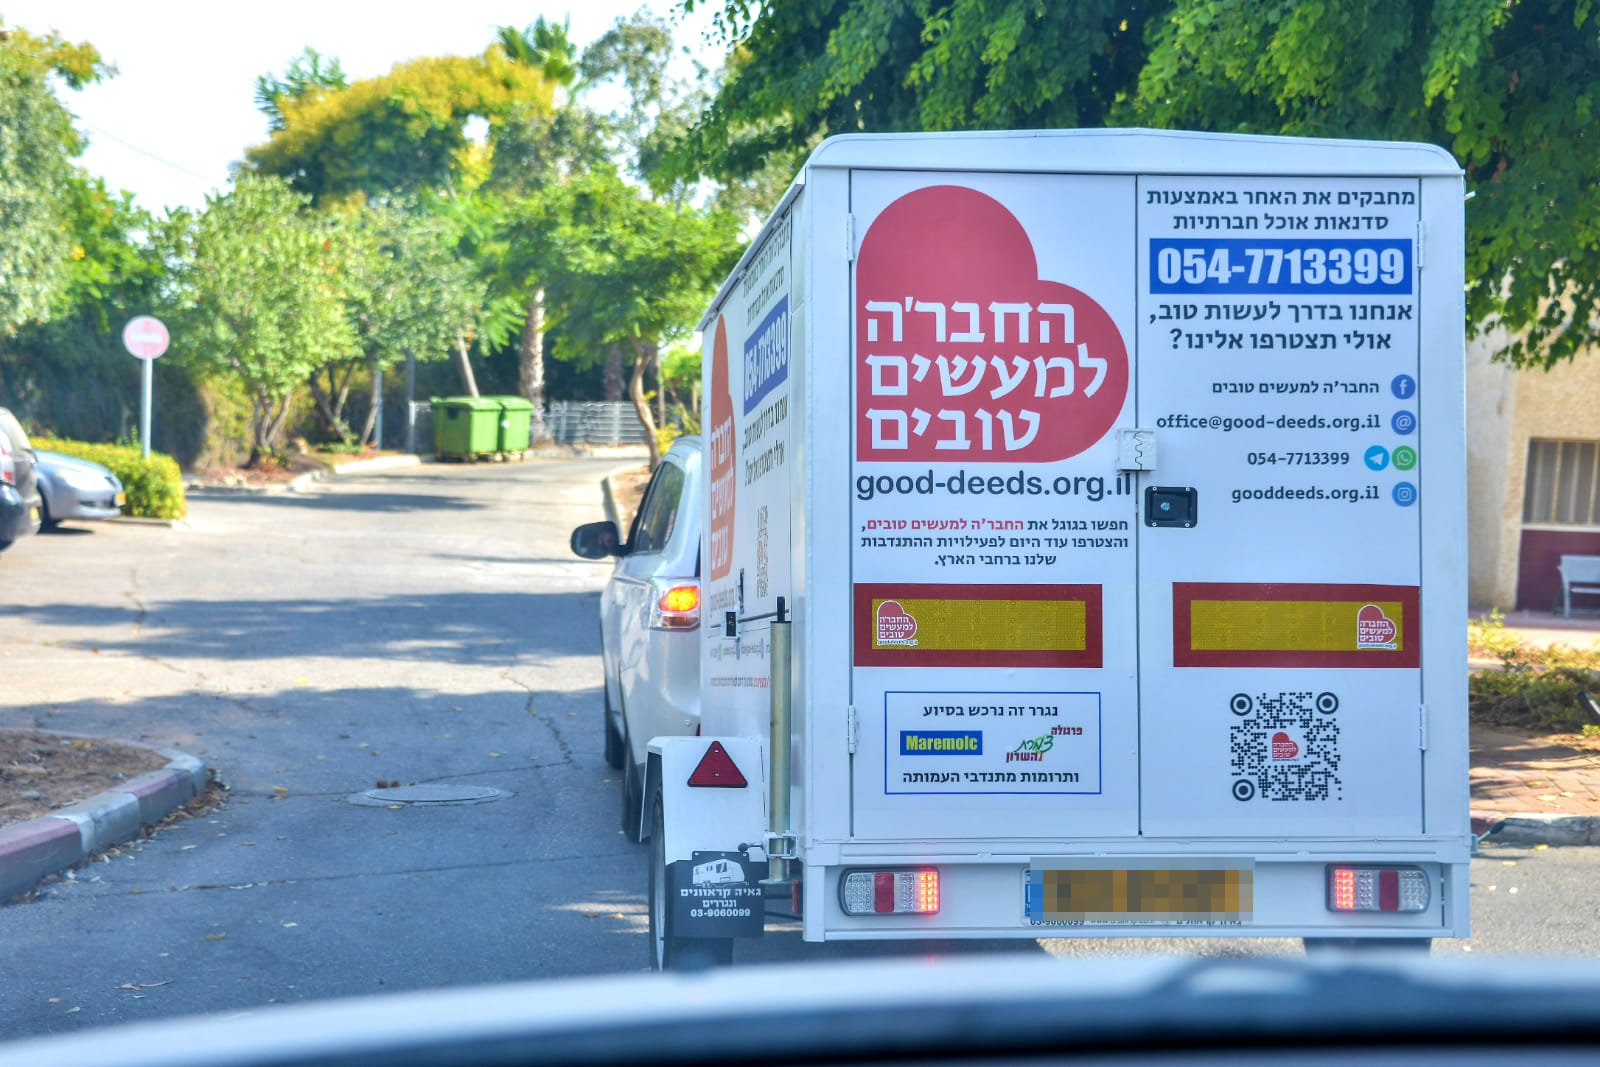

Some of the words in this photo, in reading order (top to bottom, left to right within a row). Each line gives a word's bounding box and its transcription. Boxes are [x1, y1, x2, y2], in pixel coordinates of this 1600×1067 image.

[1146, 190, 1239, 206] באמצעות
[1243, 191, 1297, 206] האחר
[1303, 191, 1332, 206] את
[1338, 191, 1416, 208] מחבקים
[1173, 215, 1259, 230] חברתיות
[1264, 212, 1309, 230] אוכל
[1313, 215, 1389, 231] סדנאות
[1157, 247, 1405, 286] 054-7713399
[1149, 303, 1198, 325] טוב,
[1205, 300, 1281, 321] לעשות
[1287, 303, 1344, 324] בדרך
[1349, 303, 1413, 321] אנחנו
[865, 296, 1075, 344] החבר'ה
[1169, 328, 1244, 350] אלינו?
[1250, 332, 1337, 350] תצטרפו
[1344, 329, 1392, 350] אולי
[865, 343, 1108, 401] למעשים
[1212, 382, 1255, 394] טובים
[1258, 379, 1319, 394] למעשים
[1323, 380, 1380, 394] החבר'ה
[865, 407, 1041, 451] טובים
[1155, 414, 1380, 434] office@good-deeds.org.il
[1247, 451, 1350, 466] 054-7713399
[856, 470, 1131, 501] good-deeds.org.il
[1231, 484, 1380, 504] gooddeeds.org.il
[861, 519, 908, 533] טובים,
[912, 516, 968, 531] למעשים
[972, 518, 1024, 531] החבר'ה
[1027, 519, 1048, 531] את
[1051, 517, 1088, 531] בגוגל
[1090, 519, 1129, 531] חפשו
[860, 536, 933, 548] ההתנדבות
[936, 534, 1006, 548] לפעילויות
[1010, 536, 1041, 548] היום
[1043, 536, 1068, 549] עוד
[1071, 536, 1129, 549] והצטרפו
[934, 554, 976, 567] הארץ.
[978, 554, 1022, 566] ברחבי
[1023, 553, 1057, 566] שלנו
[879, 631, 905, 639] טובים
[922, 706, 965, 718] בסיוע
[968, 706, 1004, 717] נרכש
[1008, 706, 1025, 717] זה
[1028, 706, 1058, 717] נגרר
[1051, 725, 1083, 736] פרגולה
[902, 772, 960, 784] העמותה
[963, 771, 1017, 784] מתנדבי
[1019, 771, 1079, 784] ותרומות
[680, 887, 731, 899] קראוונים
[734, 887, 762, 897] גאיה
[702, 898, 737, 908] ונגררים
[690, 908, 751, 918] 03-9060099
